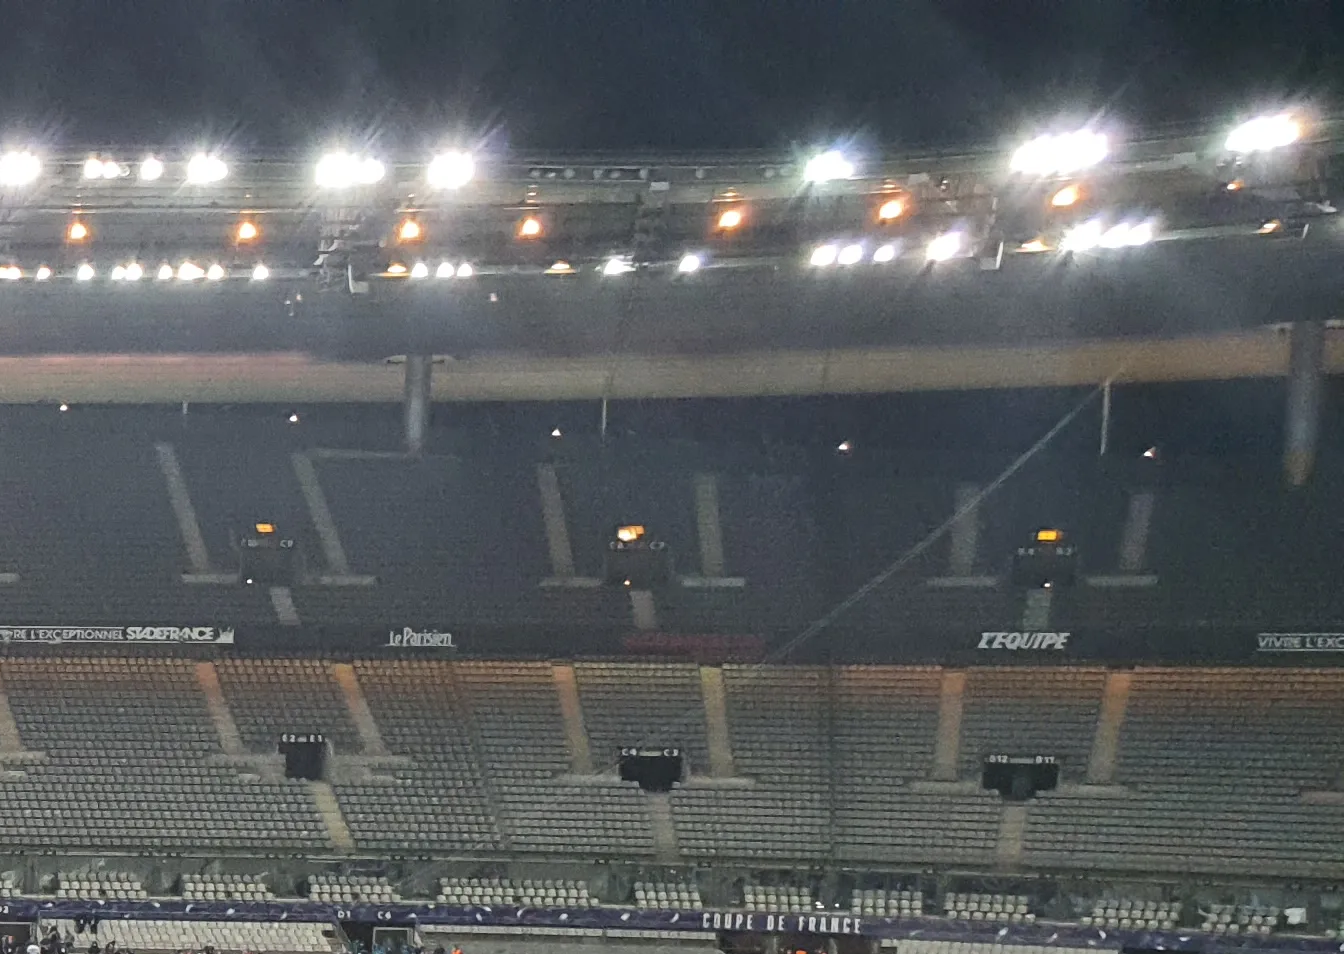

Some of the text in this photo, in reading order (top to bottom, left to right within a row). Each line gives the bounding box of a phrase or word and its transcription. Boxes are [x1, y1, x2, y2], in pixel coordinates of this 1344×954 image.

[702, 912, 861, 934] COUPE DE FRANCE
